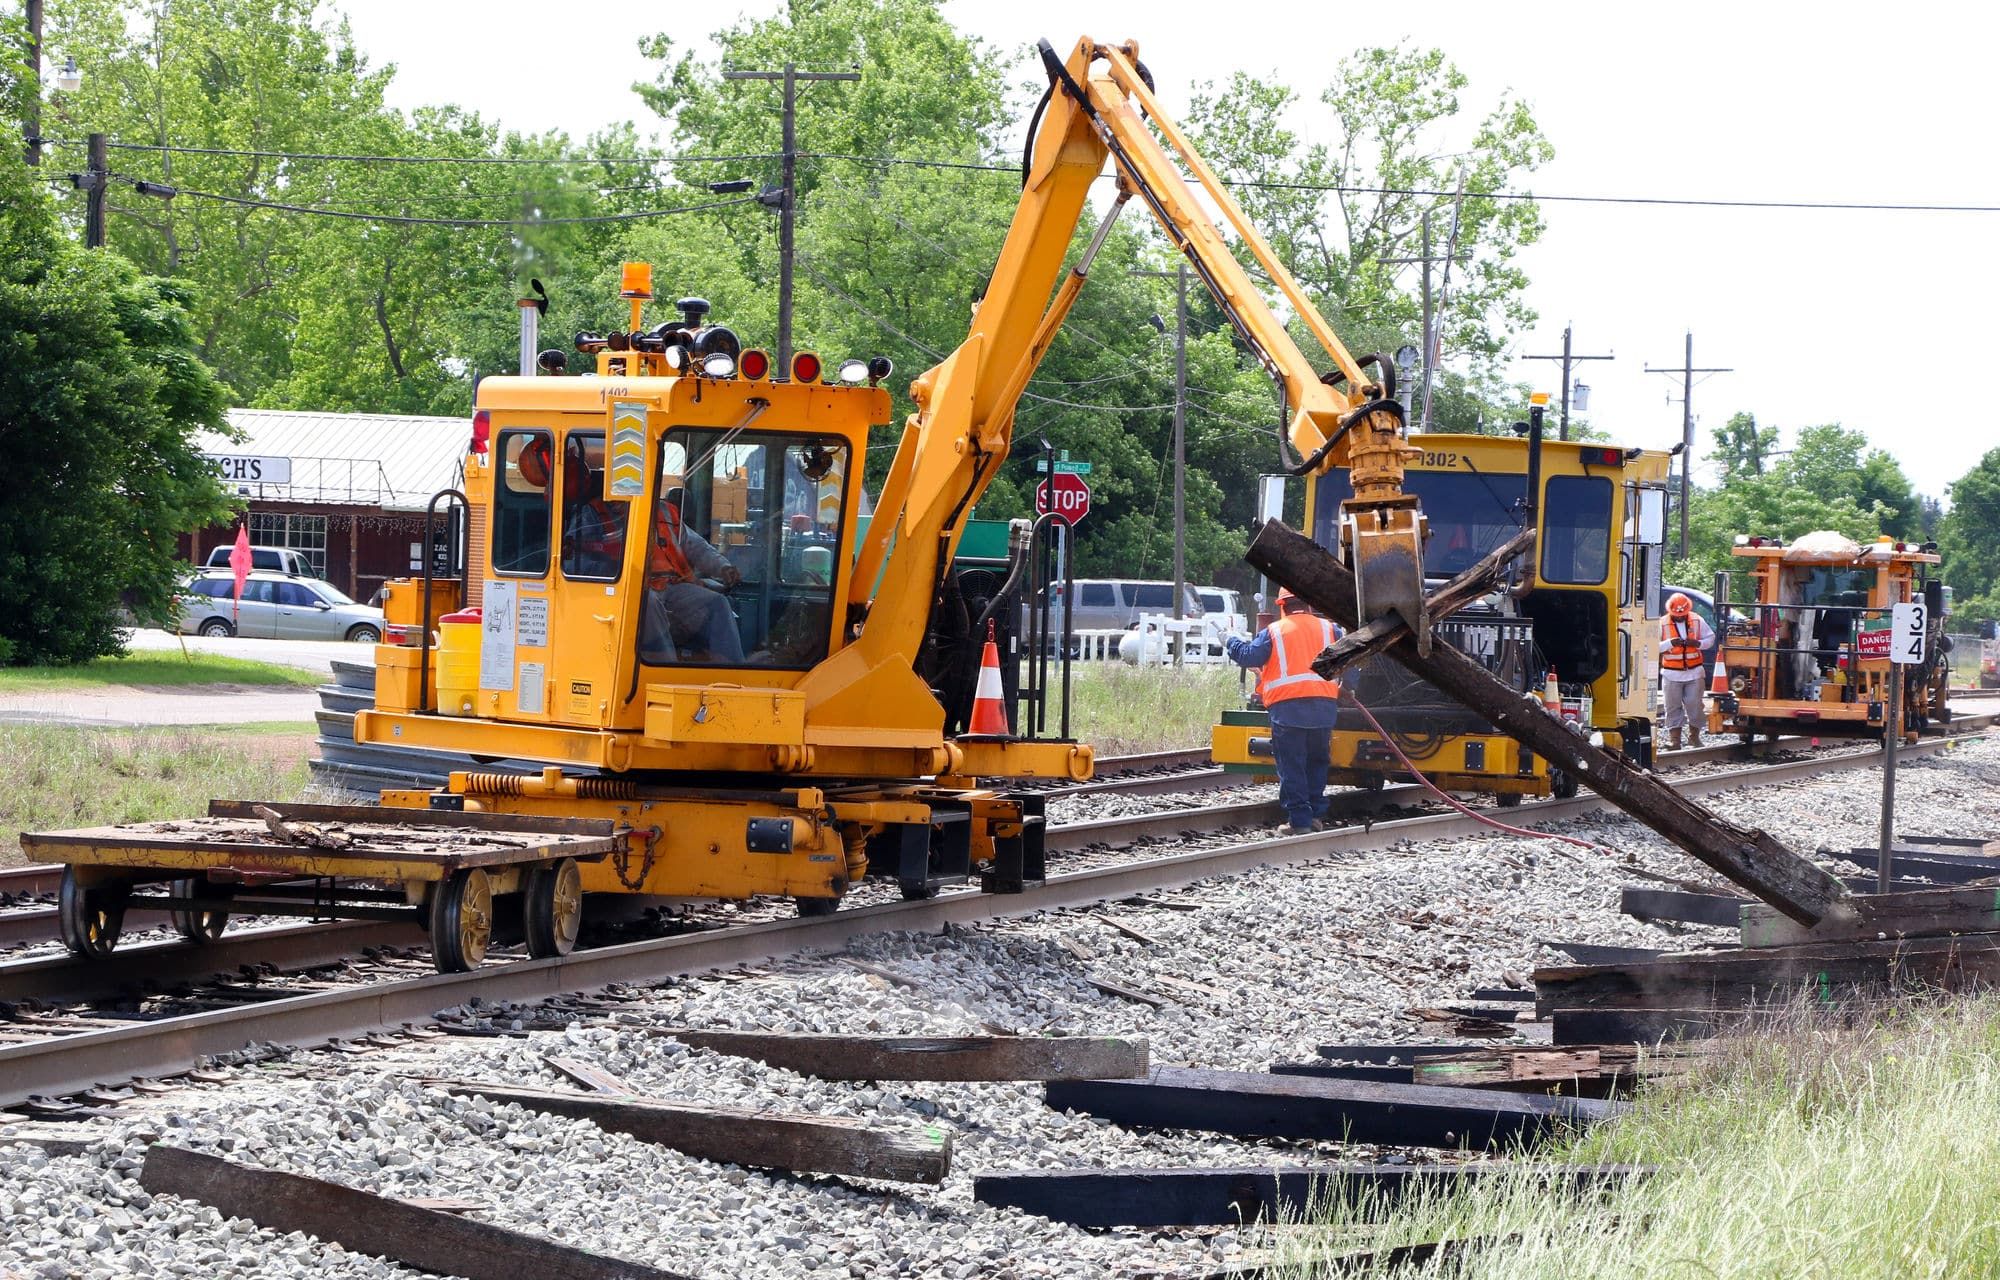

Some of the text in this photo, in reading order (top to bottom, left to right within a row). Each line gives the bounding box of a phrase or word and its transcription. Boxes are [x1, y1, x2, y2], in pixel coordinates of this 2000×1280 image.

[1039, 489, 1087, 510] STOP
[1910, 607, 1923, 631] 3
[1862, 635, 1891, 645] DANGE
[1878, 645, 1892, 653] TRA
[1908, 637, 1922, 660] 4
[572, 684, 591, 693] CAUTION
